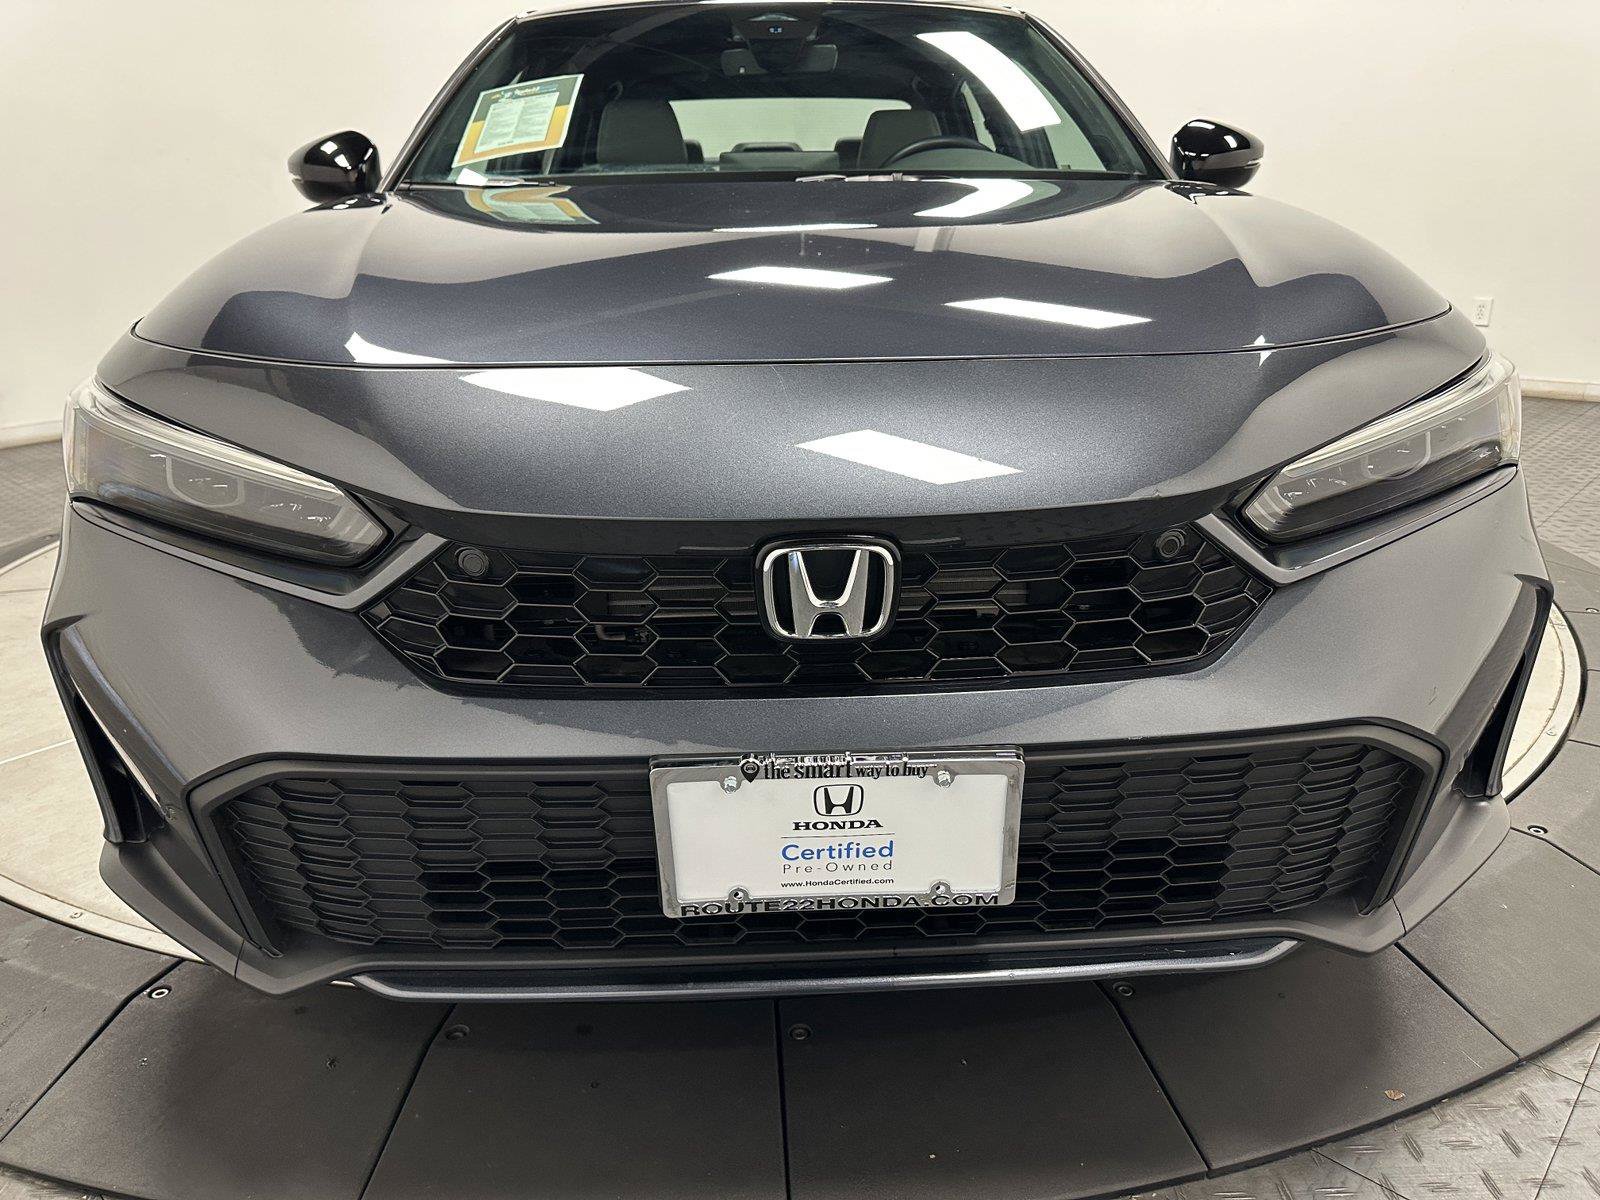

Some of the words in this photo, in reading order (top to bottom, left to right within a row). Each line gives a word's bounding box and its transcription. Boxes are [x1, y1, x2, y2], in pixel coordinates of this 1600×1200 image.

[764, 761, 791, 780] the
[794, 761, 853, 779] smart
[855, 766, 882, 780] way
[886, 762, 900, 777] to
[903, 760, 928, 779] buy
[792, 819, 884, 831] HONDA
[781, 840, 894, 861] Certified
[783, 860, 892, 874] Pre-Owned
[780, 878, 894, 888] www.HondaCertified.com
[681, 894, 999, 917] ROUTE22HONDA.COM
